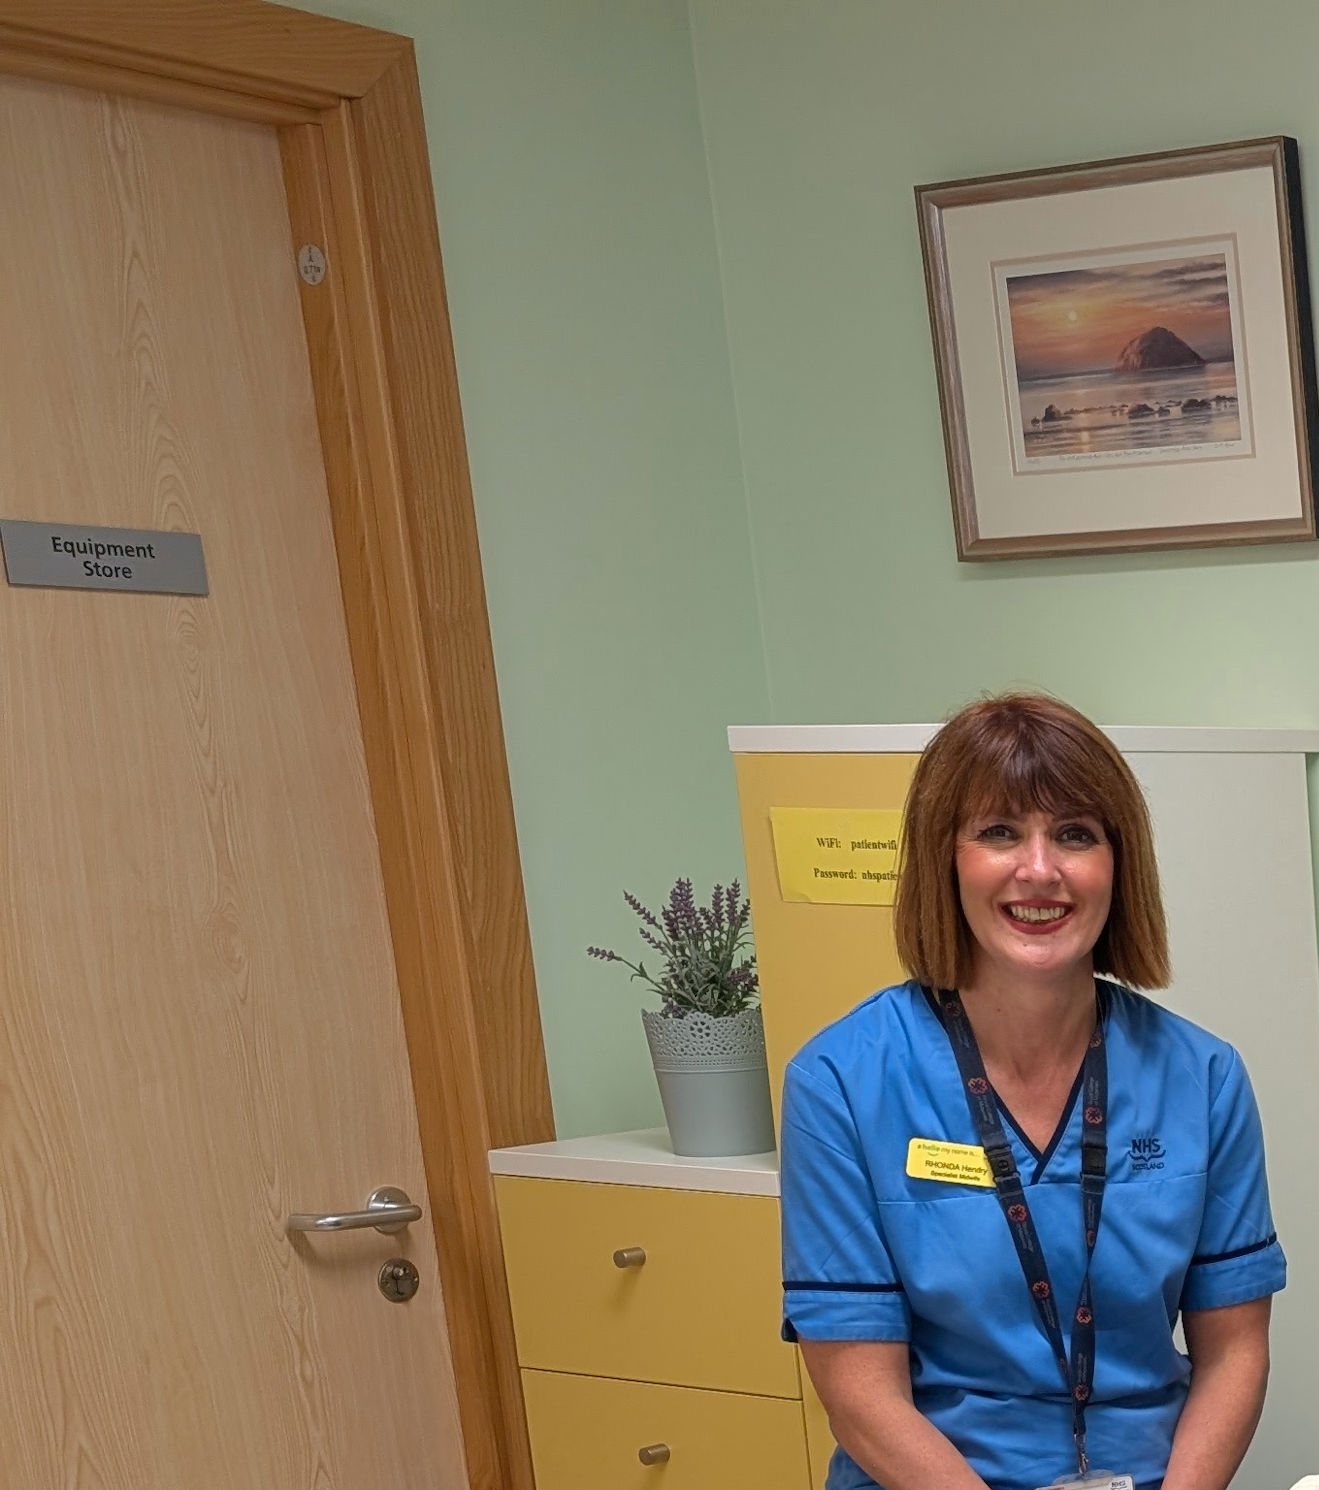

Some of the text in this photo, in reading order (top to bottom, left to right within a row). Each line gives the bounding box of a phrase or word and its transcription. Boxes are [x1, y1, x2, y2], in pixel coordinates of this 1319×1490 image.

[51, 536, 156, 560] Equipment
[83, 561, 133, 579] Store
[813, 867, 857, 880] Password:
[1131, 1138, 1161, 1154] NHS
[924, 1159, 961, 1171] RHONDA
